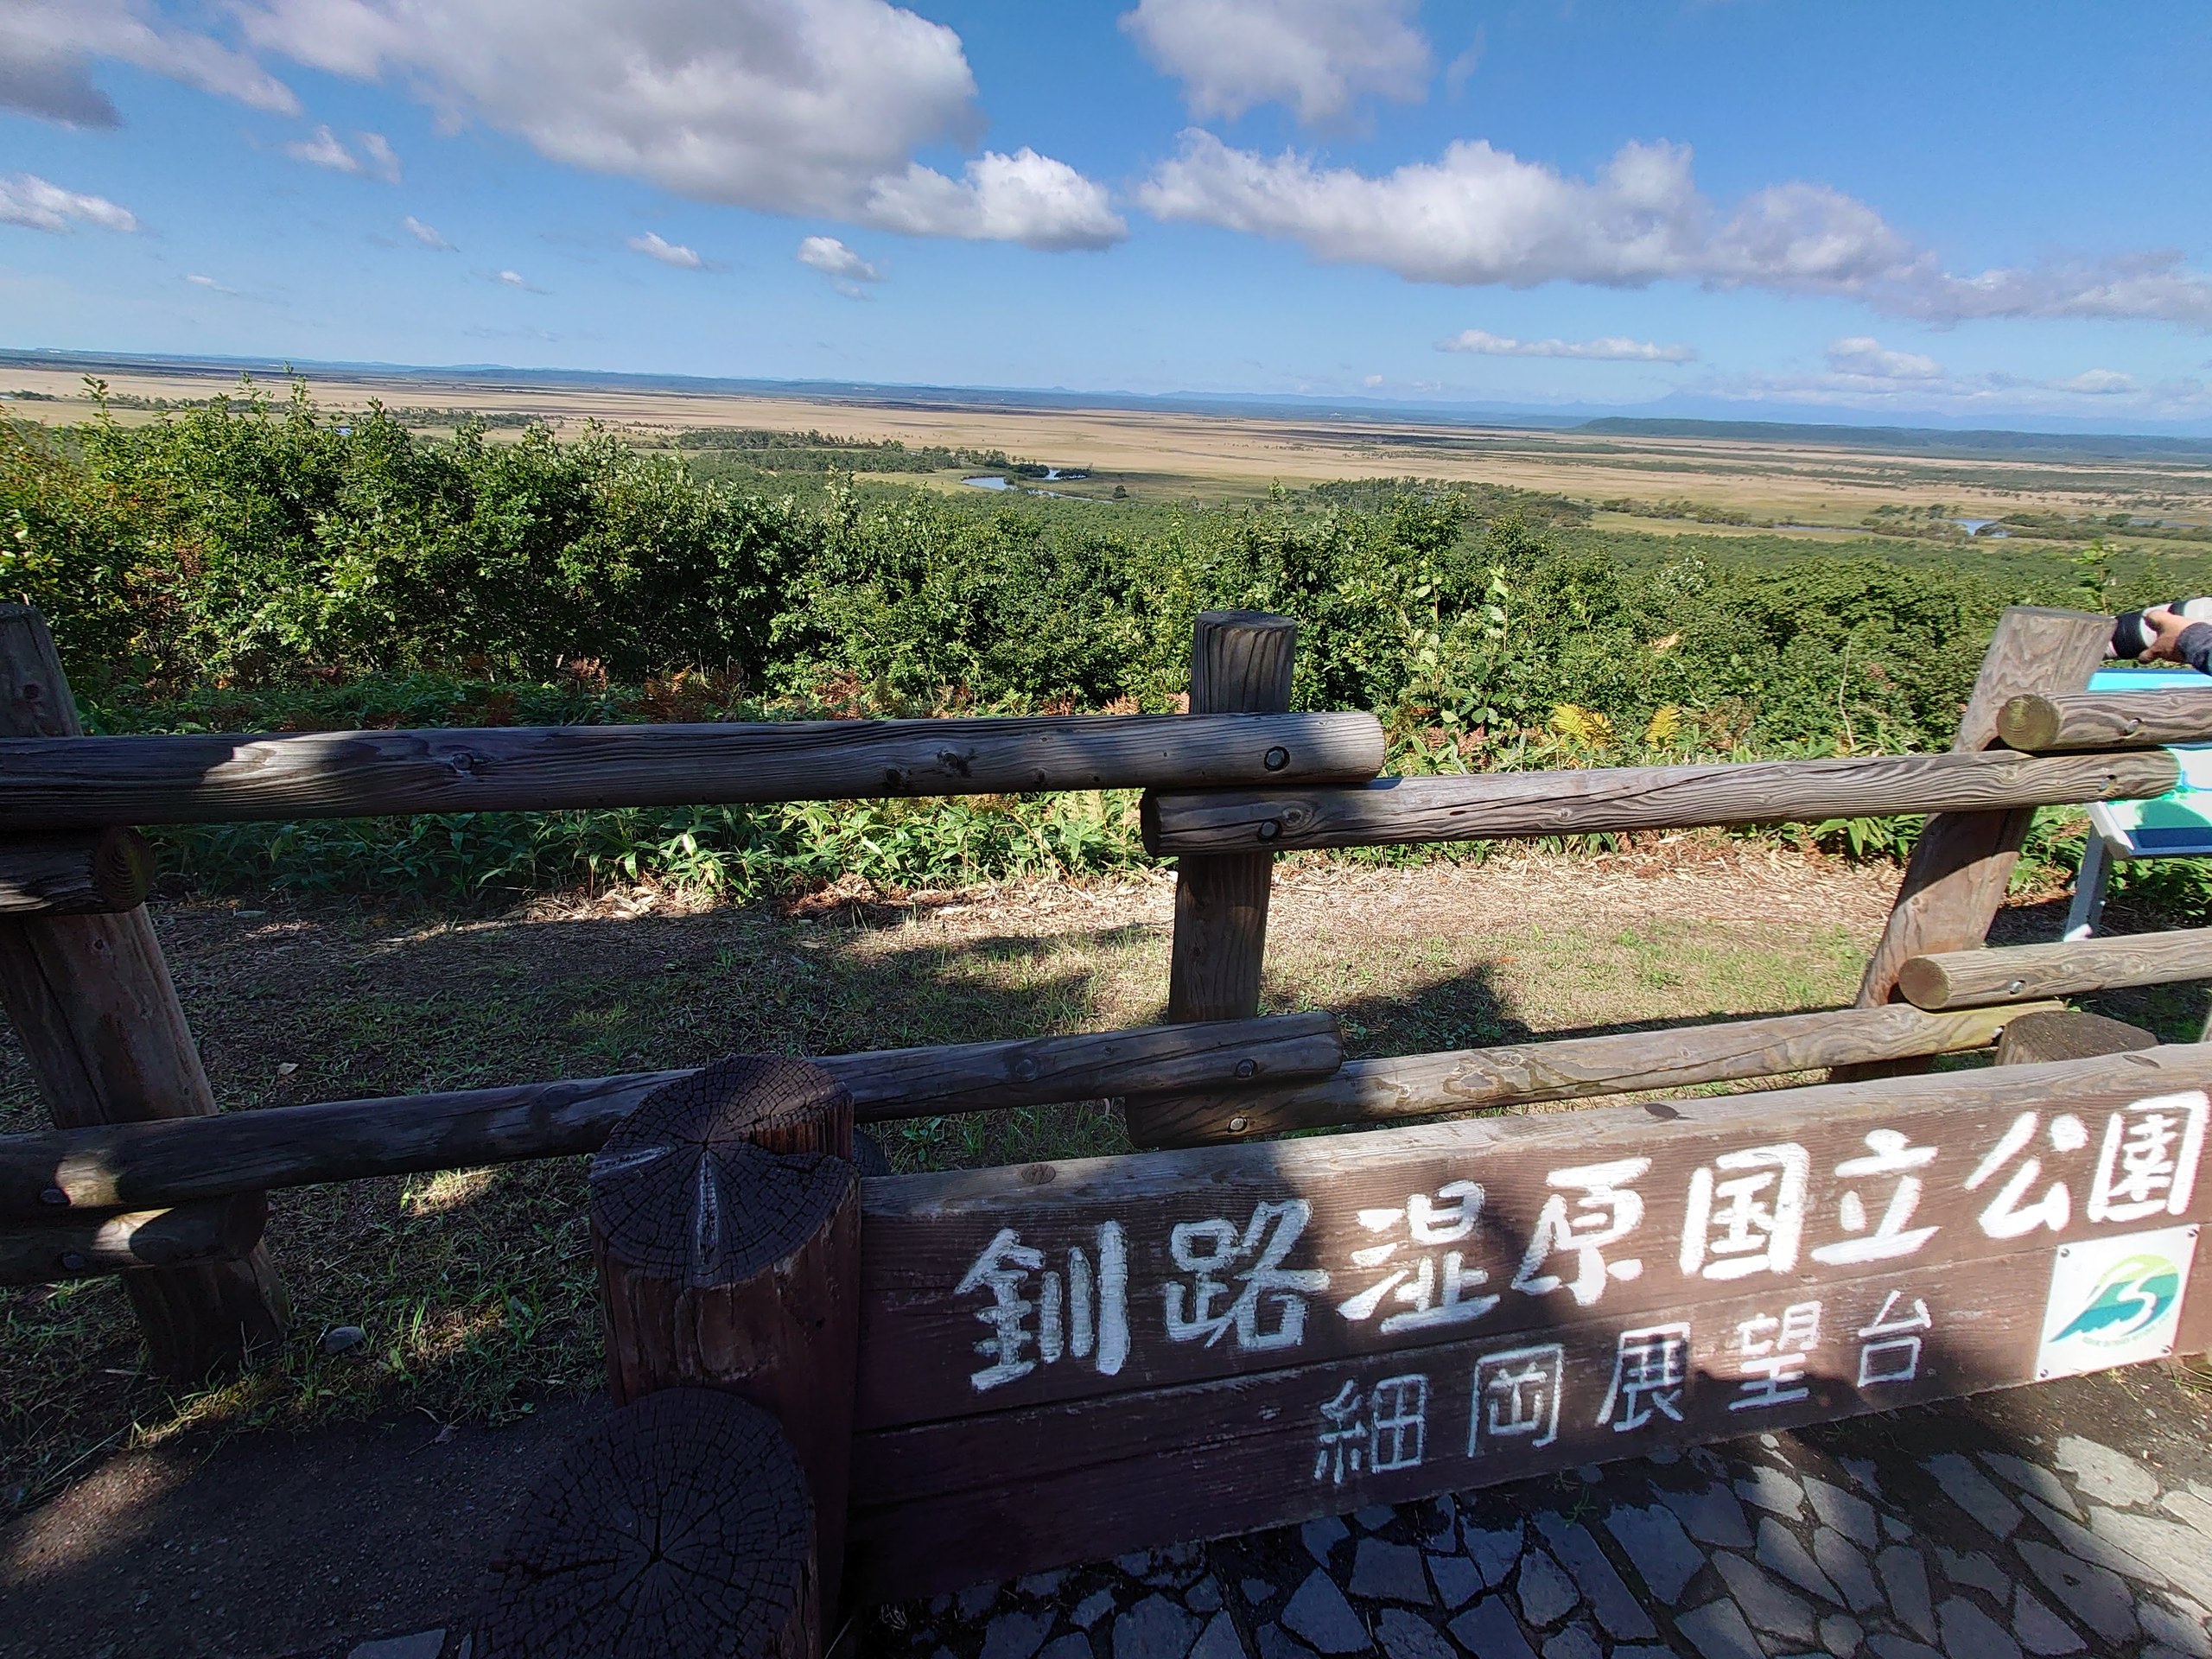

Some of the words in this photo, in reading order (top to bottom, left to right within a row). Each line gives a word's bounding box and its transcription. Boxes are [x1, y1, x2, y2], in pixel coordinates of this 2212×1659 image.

[954, 1090, 2210, 1391] 釧路湿原国立公園
[1313, 1290, 1933, 1484] 細岡展望台
